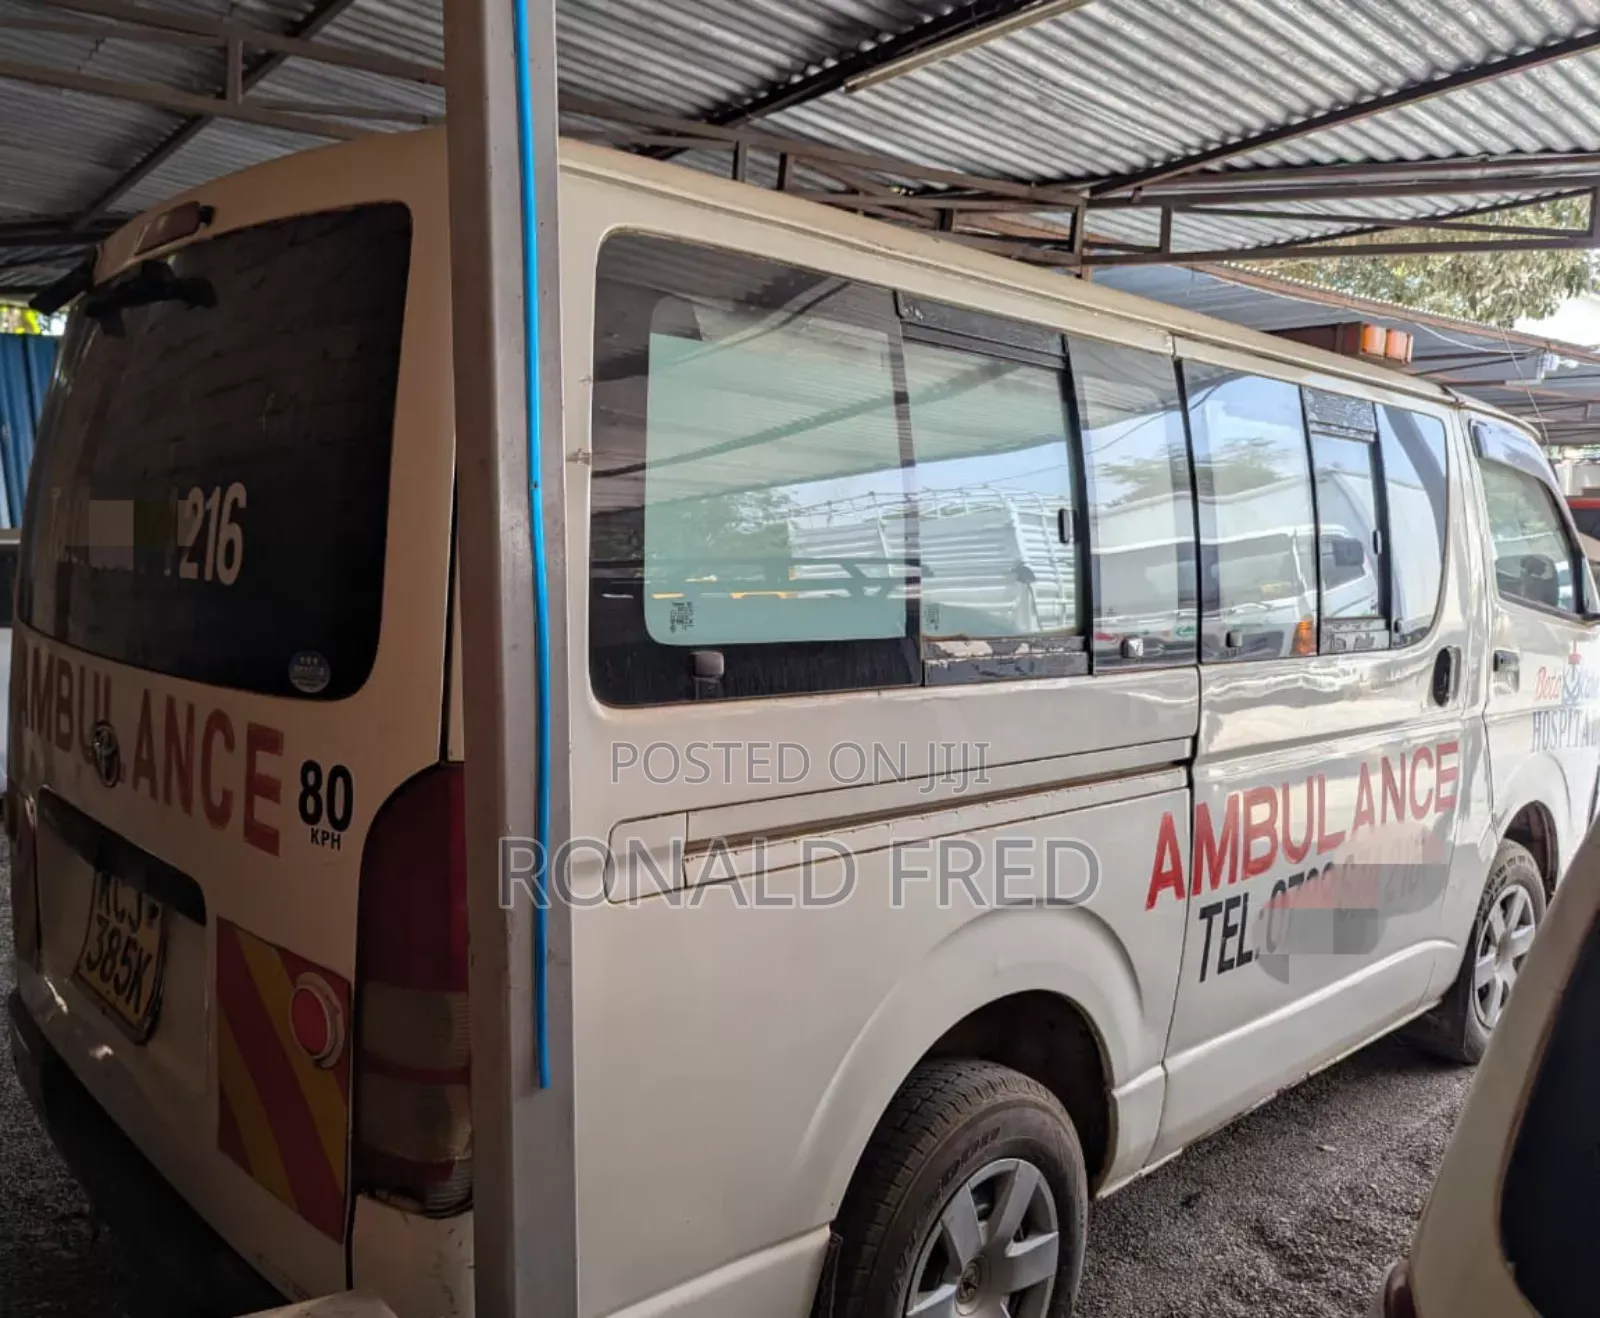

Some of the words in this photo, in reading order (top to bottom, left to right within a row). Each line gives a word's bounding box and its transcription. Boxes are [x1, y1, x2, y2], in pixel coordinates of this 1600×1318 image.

[298, 760, 354, 832] 80
[1145, 739, 1459, 911] AMBULANCE
[310, 827, 341, 851] KPH
